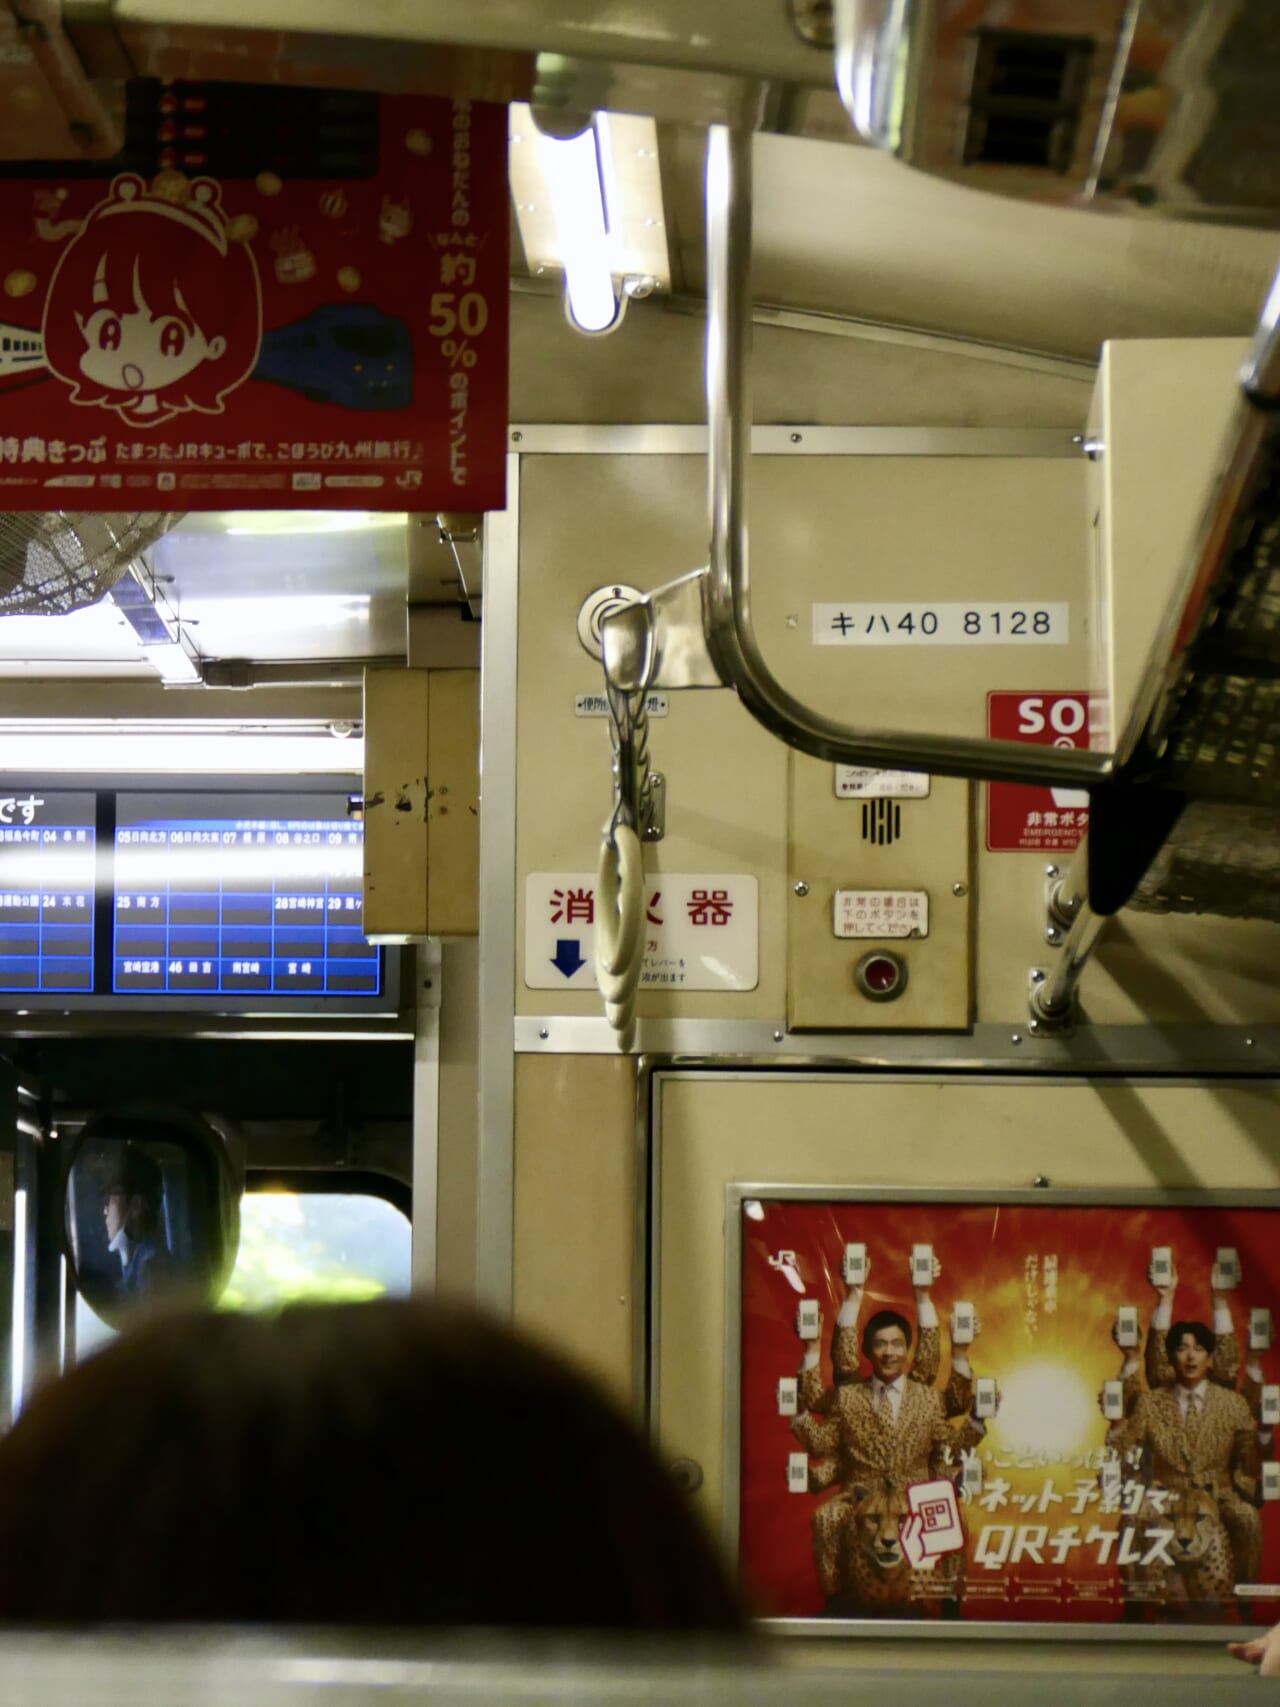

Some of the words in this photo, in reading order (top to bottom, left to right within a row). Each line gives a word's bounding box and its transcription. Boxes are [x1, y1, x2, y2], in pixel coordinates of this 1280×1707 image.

[830, 611, 938, 636] キハ40
[964, 611, 1052, 636] 8128
[1018, 698, 1108, 734] SO
[1027, 811, 1089, 827] 非常ボタ
[43, 830, 57, 843] 04
[223, 832, 236, 844] 07
[43, 895, 56, 907] 24
[328, 897, 341, 909] 29
[169, 961, 182, 974] 46
[980, 1480, 1180, 1512] ネット予約で
[973, 1526, 1177, 1570] QRチケレス
